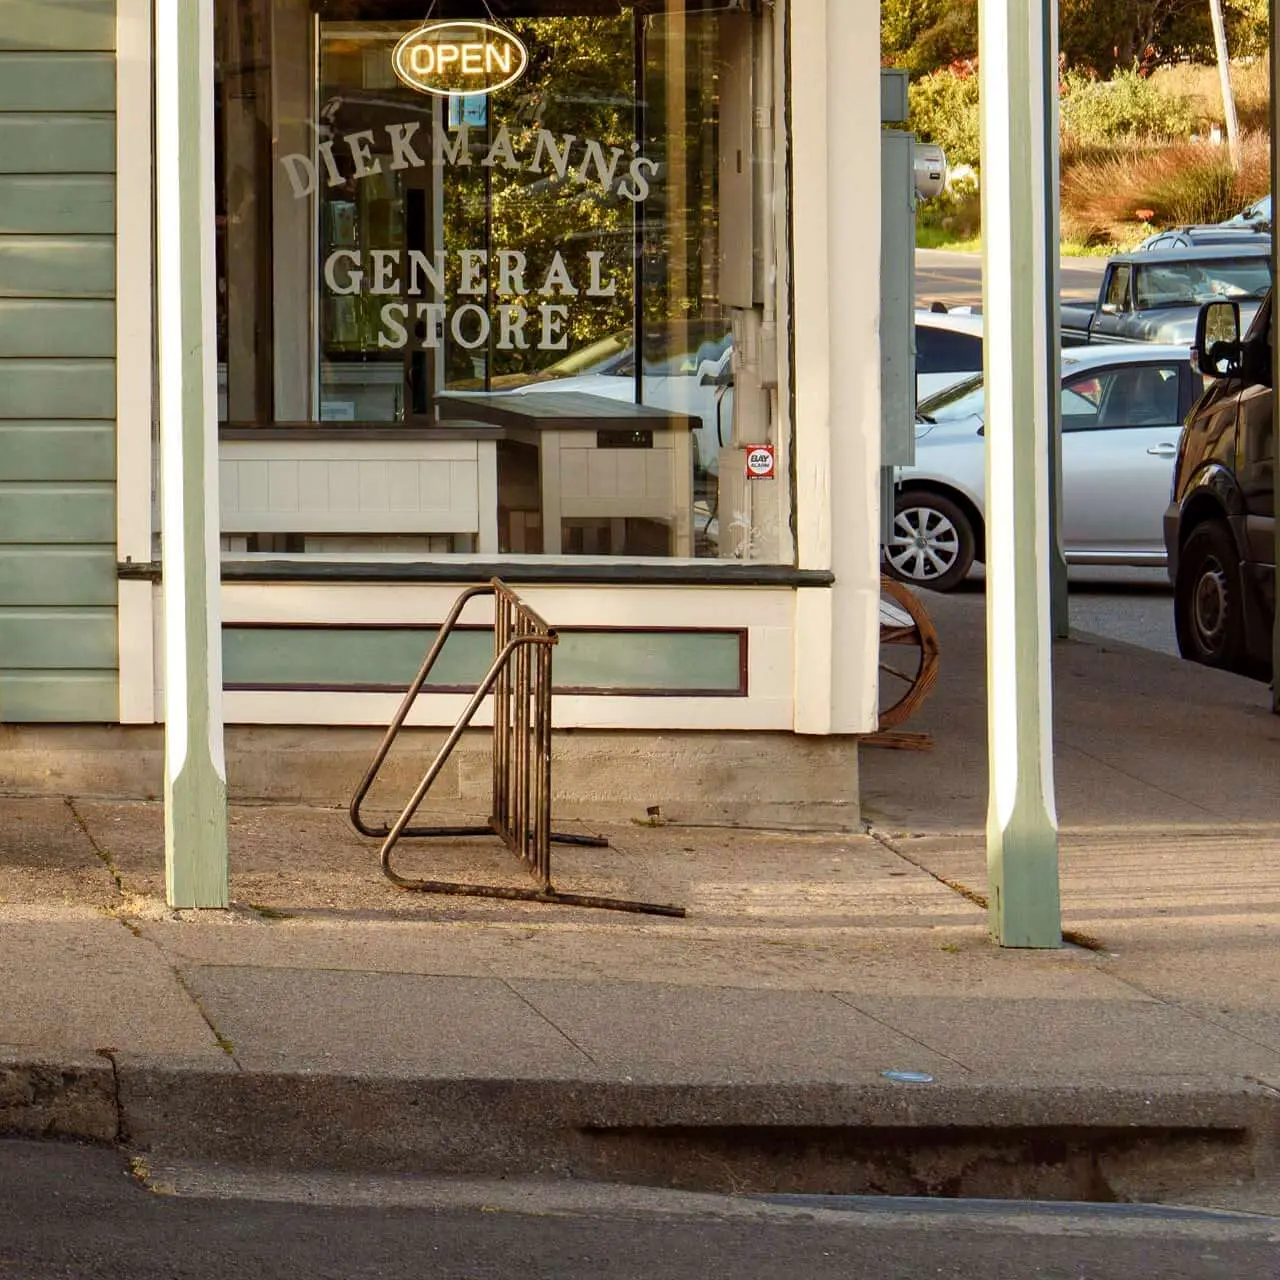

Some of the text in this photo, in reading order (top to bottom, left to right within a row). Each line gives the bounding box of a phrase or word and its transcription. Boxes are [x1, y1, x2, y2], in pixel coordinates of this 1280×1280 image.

[409, 41, 512, 75] OPEN
[281, 121, 660, 202] DIEKMANN'S
[324, 249, 616, 297] GENERAL
[377, 303, 569, 351] STORE
[750, 455, 769, 463] BAY
